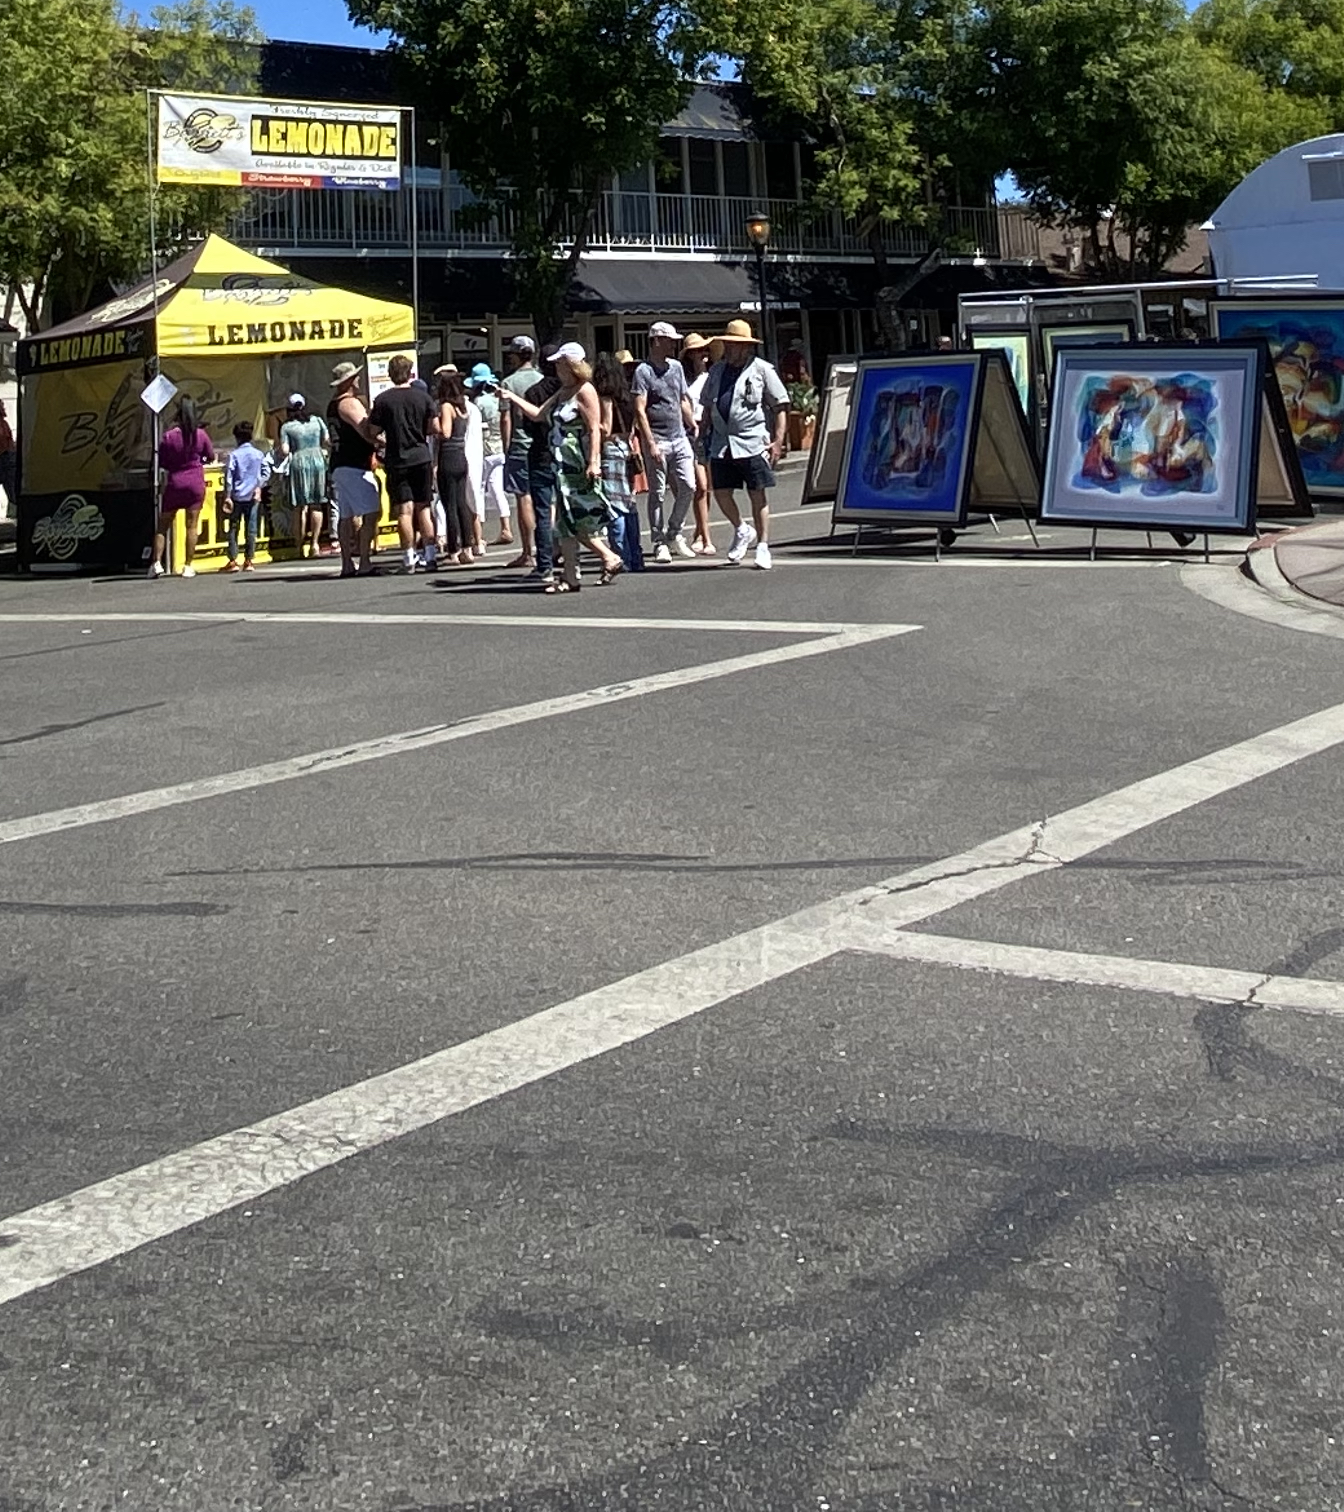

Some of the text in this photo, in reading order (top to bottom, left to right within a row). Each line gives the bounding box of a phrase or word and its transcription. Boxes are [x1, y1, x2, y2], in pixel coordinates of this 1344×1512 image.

[251, 118, 396, 157] LEMONADE
[39, 330, 126, 365] LEMONADE
[207, 318, 364, 346] LEMONADE
